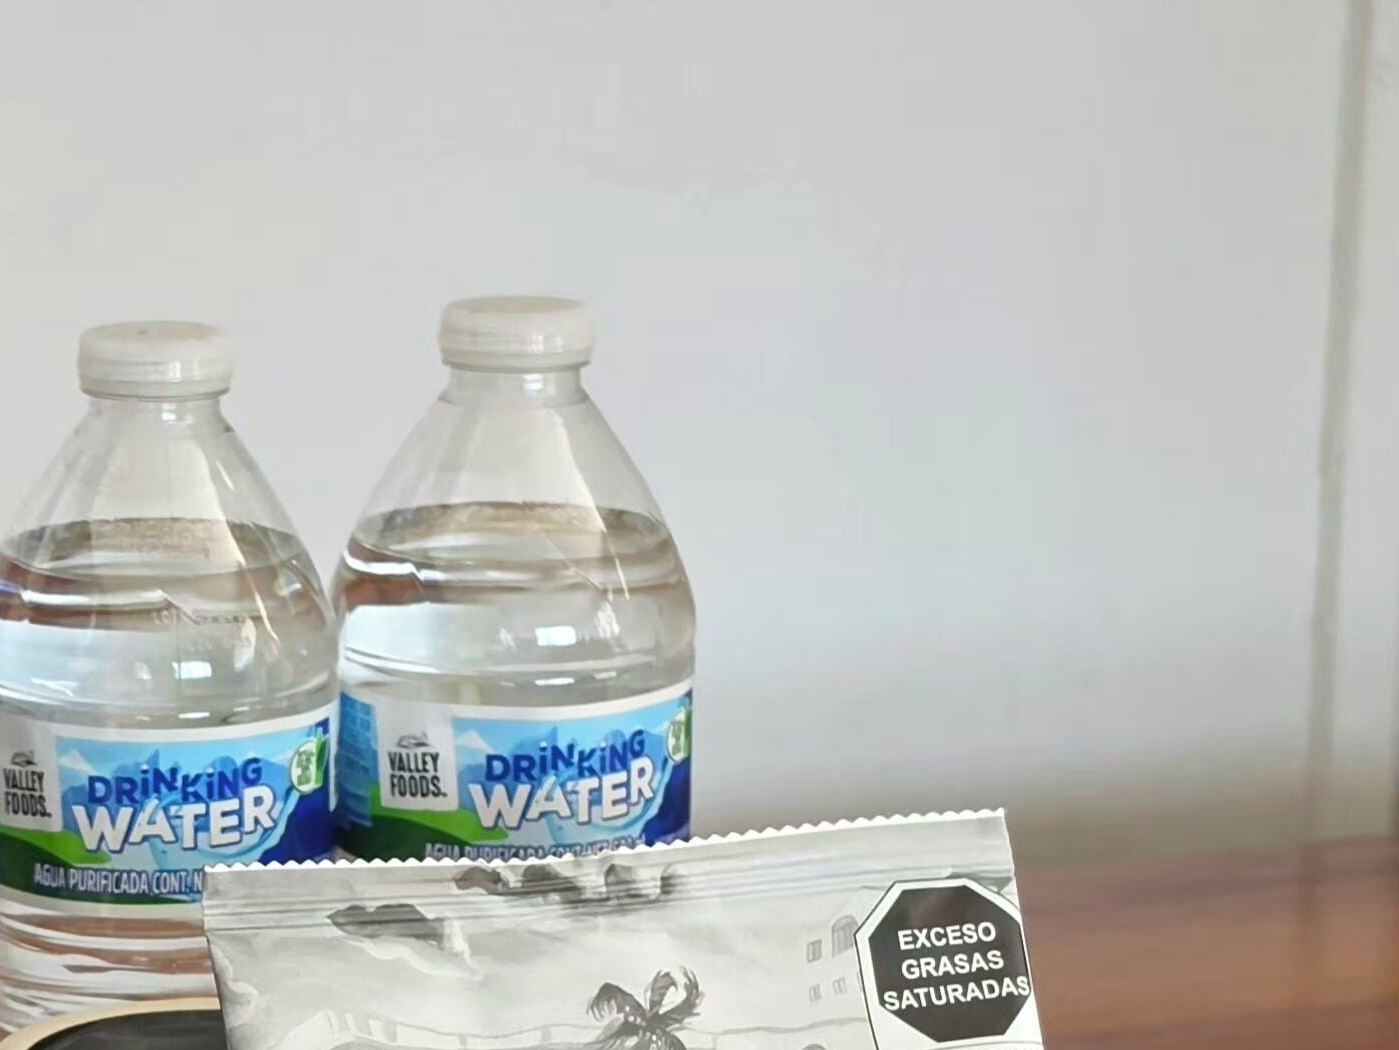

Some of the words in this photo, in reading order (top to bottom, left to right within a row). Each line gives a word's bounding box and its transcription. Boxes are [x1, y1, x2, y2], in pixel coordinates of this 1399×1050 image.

[387, 751, 440, 774] VALLEY
[2, 767, 45, 793] VALLEY
[468, 757, 656, 830] WATER
[71, 785, 277, 854] WATER
[33, 862, 65, 888] AGUA
[897, 921, 996, 951] EXCESO
[901, 950, 1004, 981] GRASAS
[883, 975, 1031, 1012] SATURADAS
